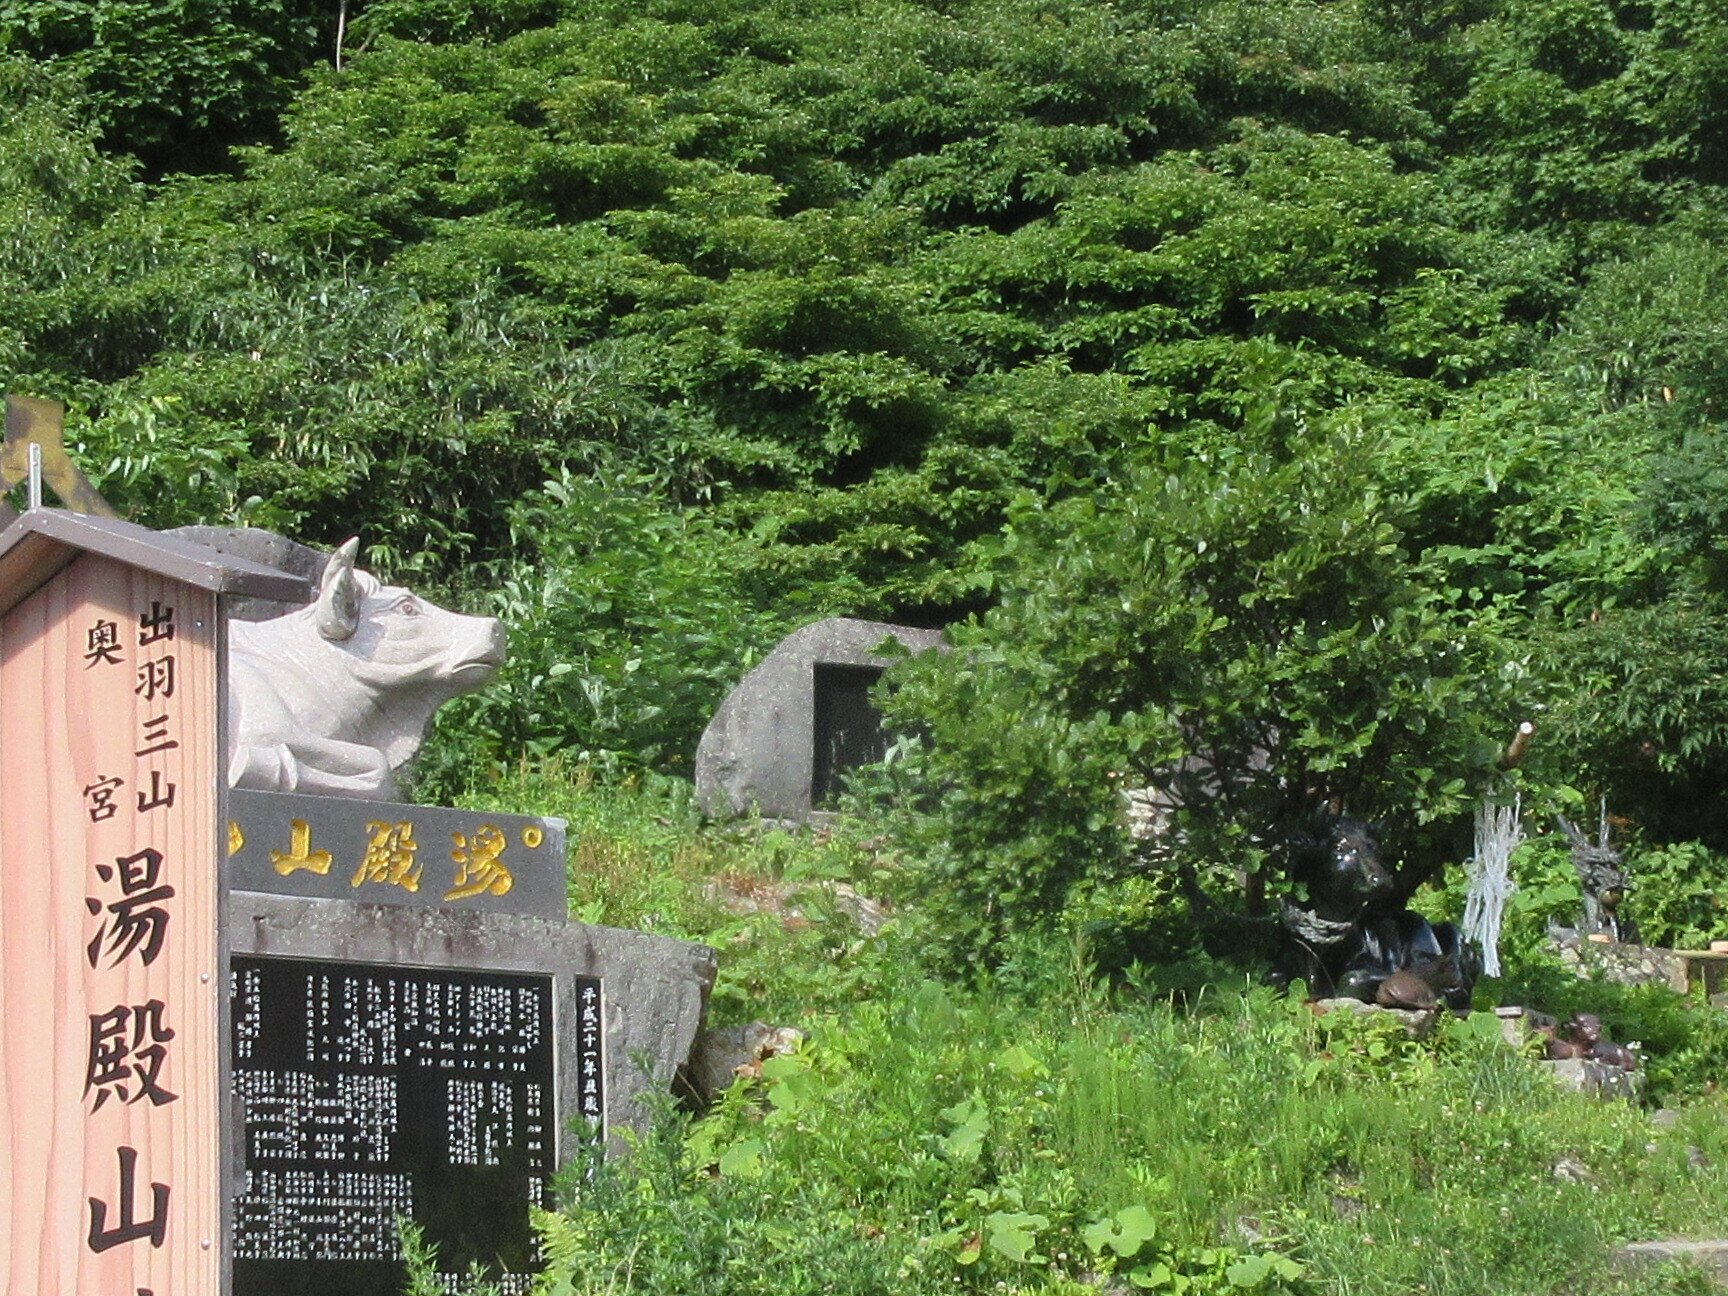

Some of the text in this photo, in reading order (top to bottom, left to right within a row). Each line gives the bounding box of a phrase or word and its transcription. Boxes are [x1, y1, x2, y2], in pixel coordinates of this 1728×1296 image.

[135, 601, 179, 814] 出羽三山
[228, 818, 514, 902] 湯殿山
